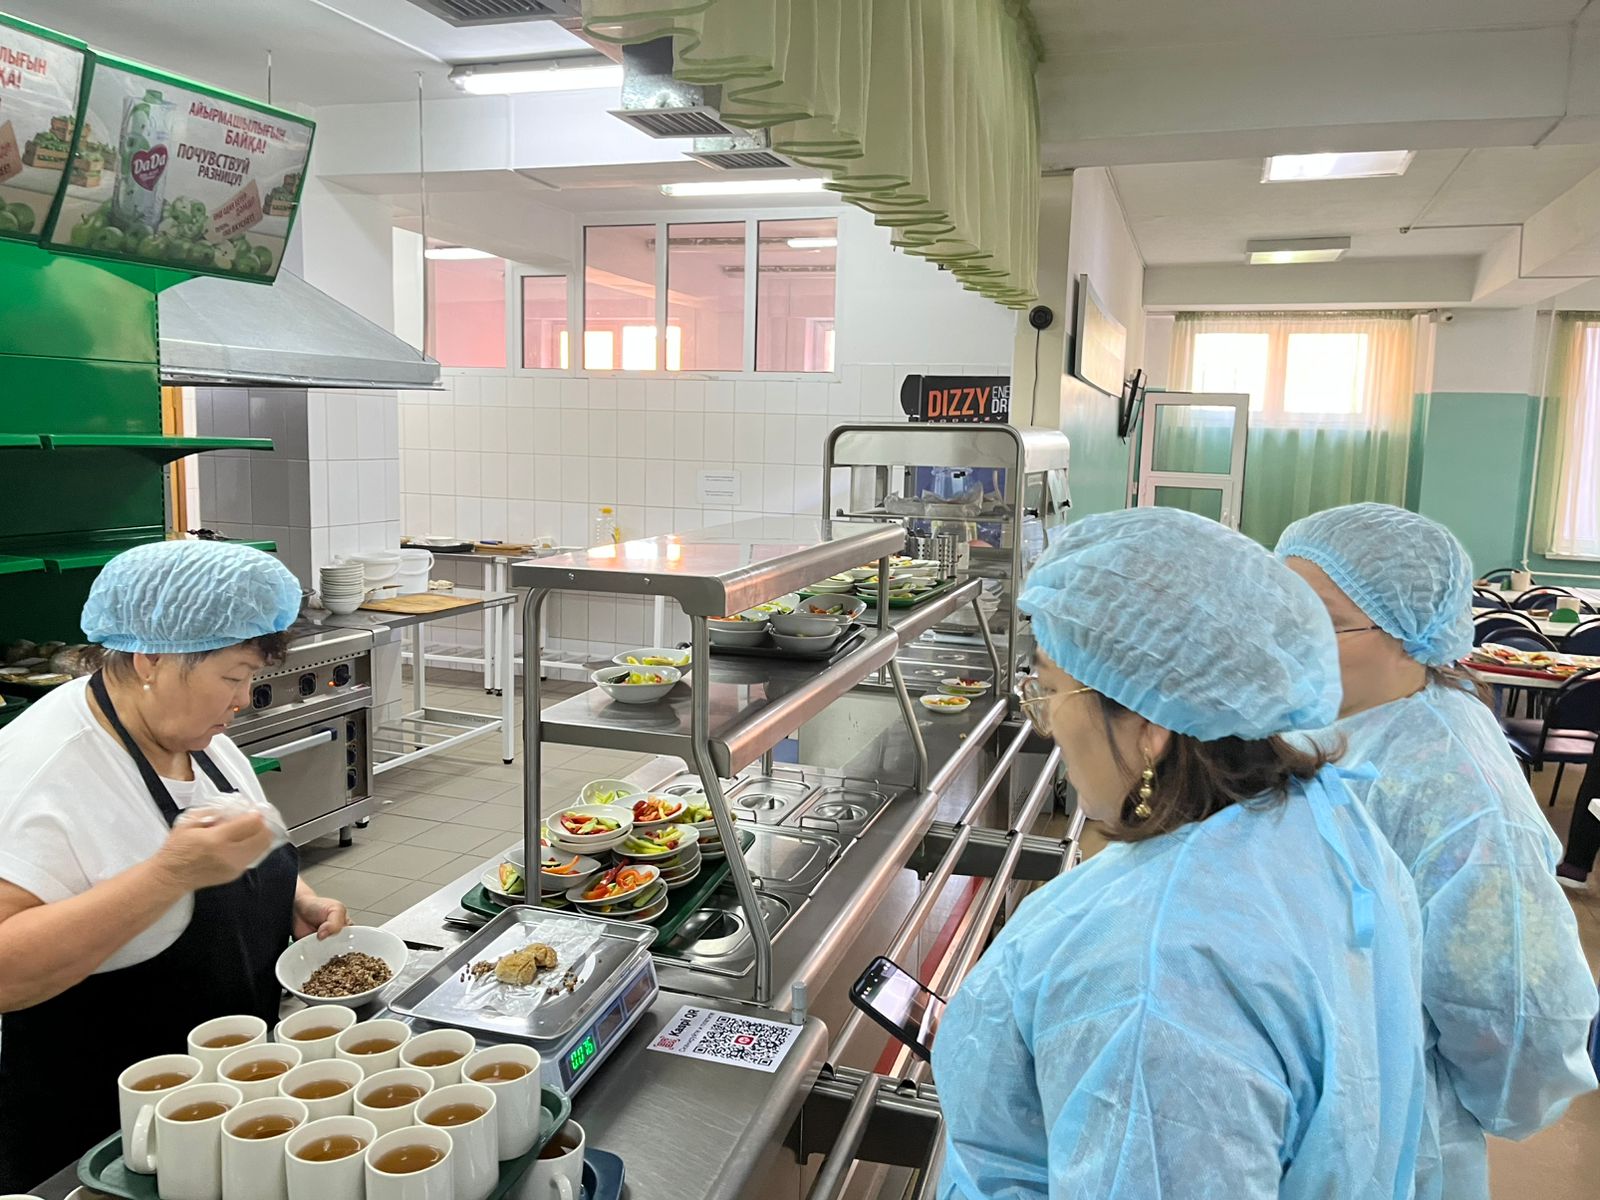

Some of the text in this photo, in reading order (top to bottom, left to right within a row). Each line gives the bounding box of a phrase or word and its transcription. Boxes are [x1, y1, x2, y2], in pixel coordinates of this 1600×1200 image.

[133, 153, 166, 174] DaDa
[177, 143, 250, 175] ПОЧУВСТВУЙ
[198, 165, 242, 186] РАЗНИЦУ!
[928, 387, 990, 417] DIZZY
[668, 1018, 692, 1037] Kaspi
[684, 1009, 700, 1019] QR
